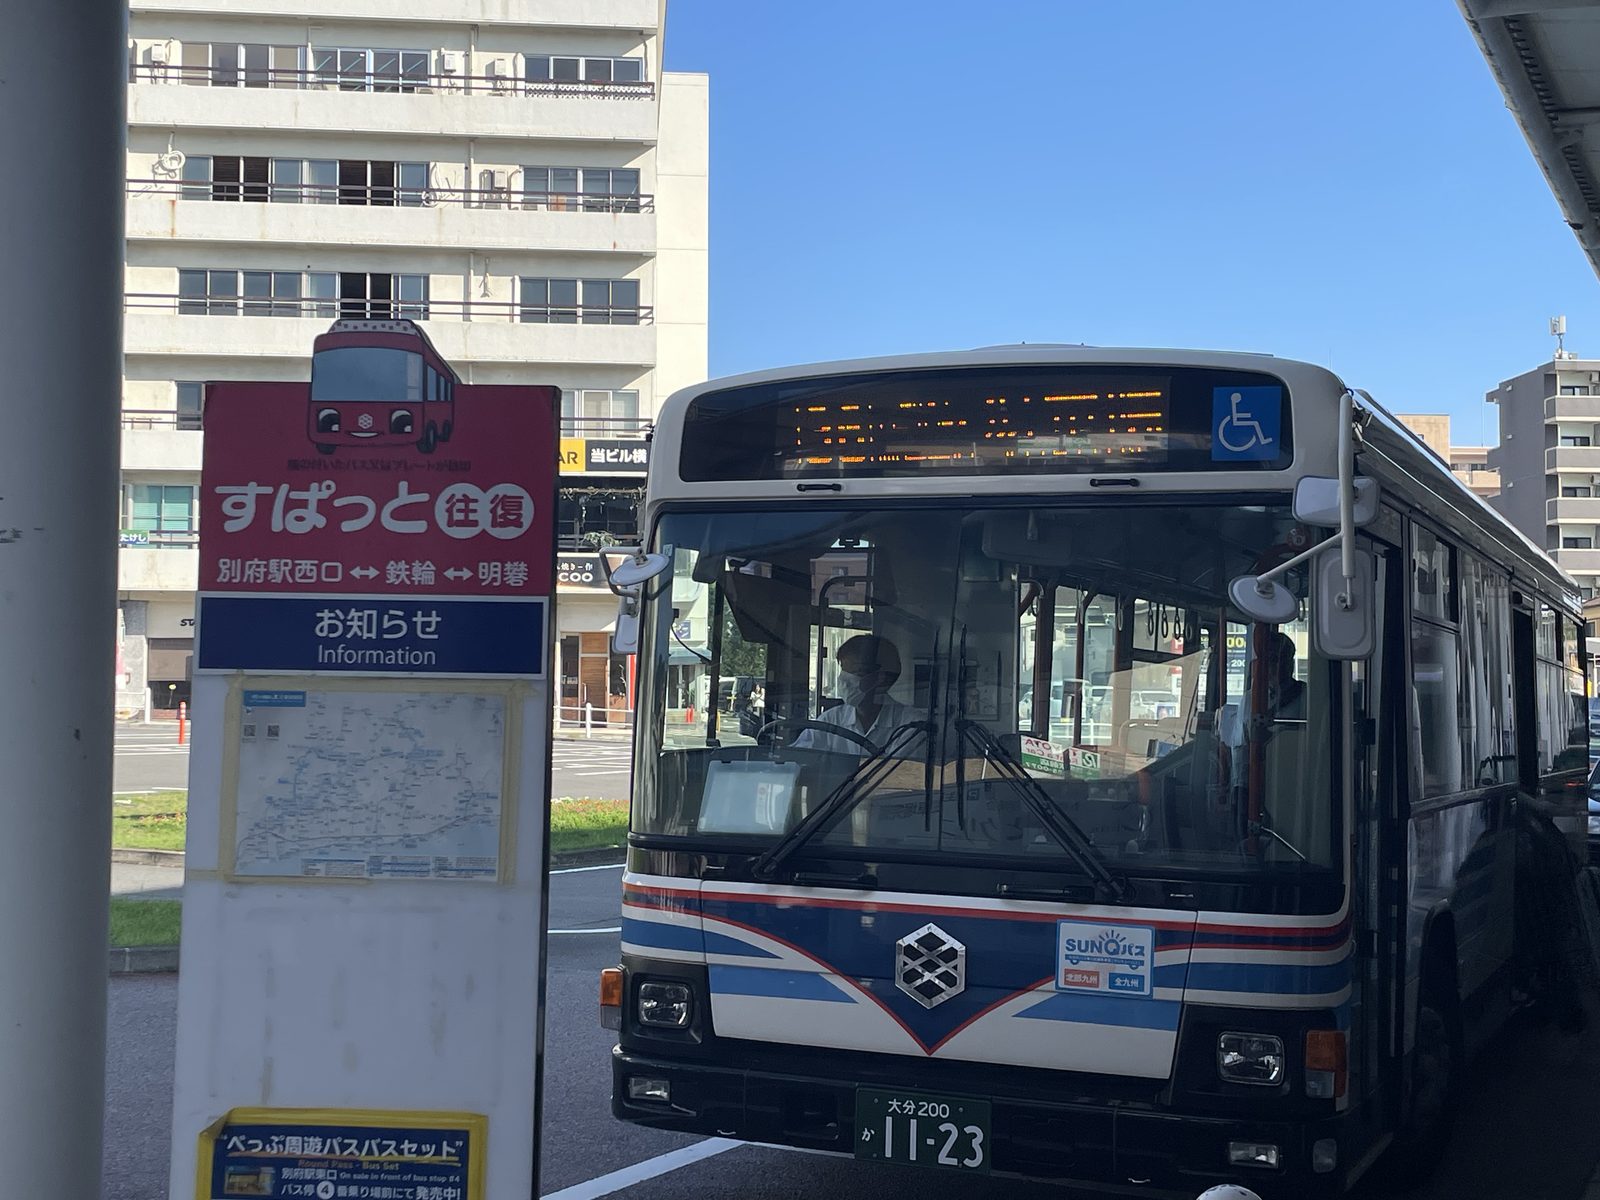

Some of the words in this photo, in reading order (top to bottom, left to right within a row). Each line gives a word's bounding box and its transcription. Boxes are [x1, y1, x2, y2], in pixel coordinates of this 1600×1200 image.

[590, 448, 647, 463] 当ビル横
[215, 480, 528, 535] すぱっと往復
[217, 558, 343, 584] 別府駅西口
[386, 560, 436, 585] 鉄輪
[478, 561, 529, 586] 明礬
[314, 609, 442, 640] お知らせ
[318, 644, 437, 666] Information
[1065, 938, 1145, 957] SUNQパス
[1114, 977, 1139, 988] 全九州
[862, 1127, 874, 1141] か
[884, 1116, 984, 1168] 11-23
[298, 1159, 328, 1168] Round
[363, 1161, 380, 1170] Bus
[383, 1162, 399, 1170] Set
[402, 1173, 411, 1181] of
[428, 1175, 447, 1183] stop
